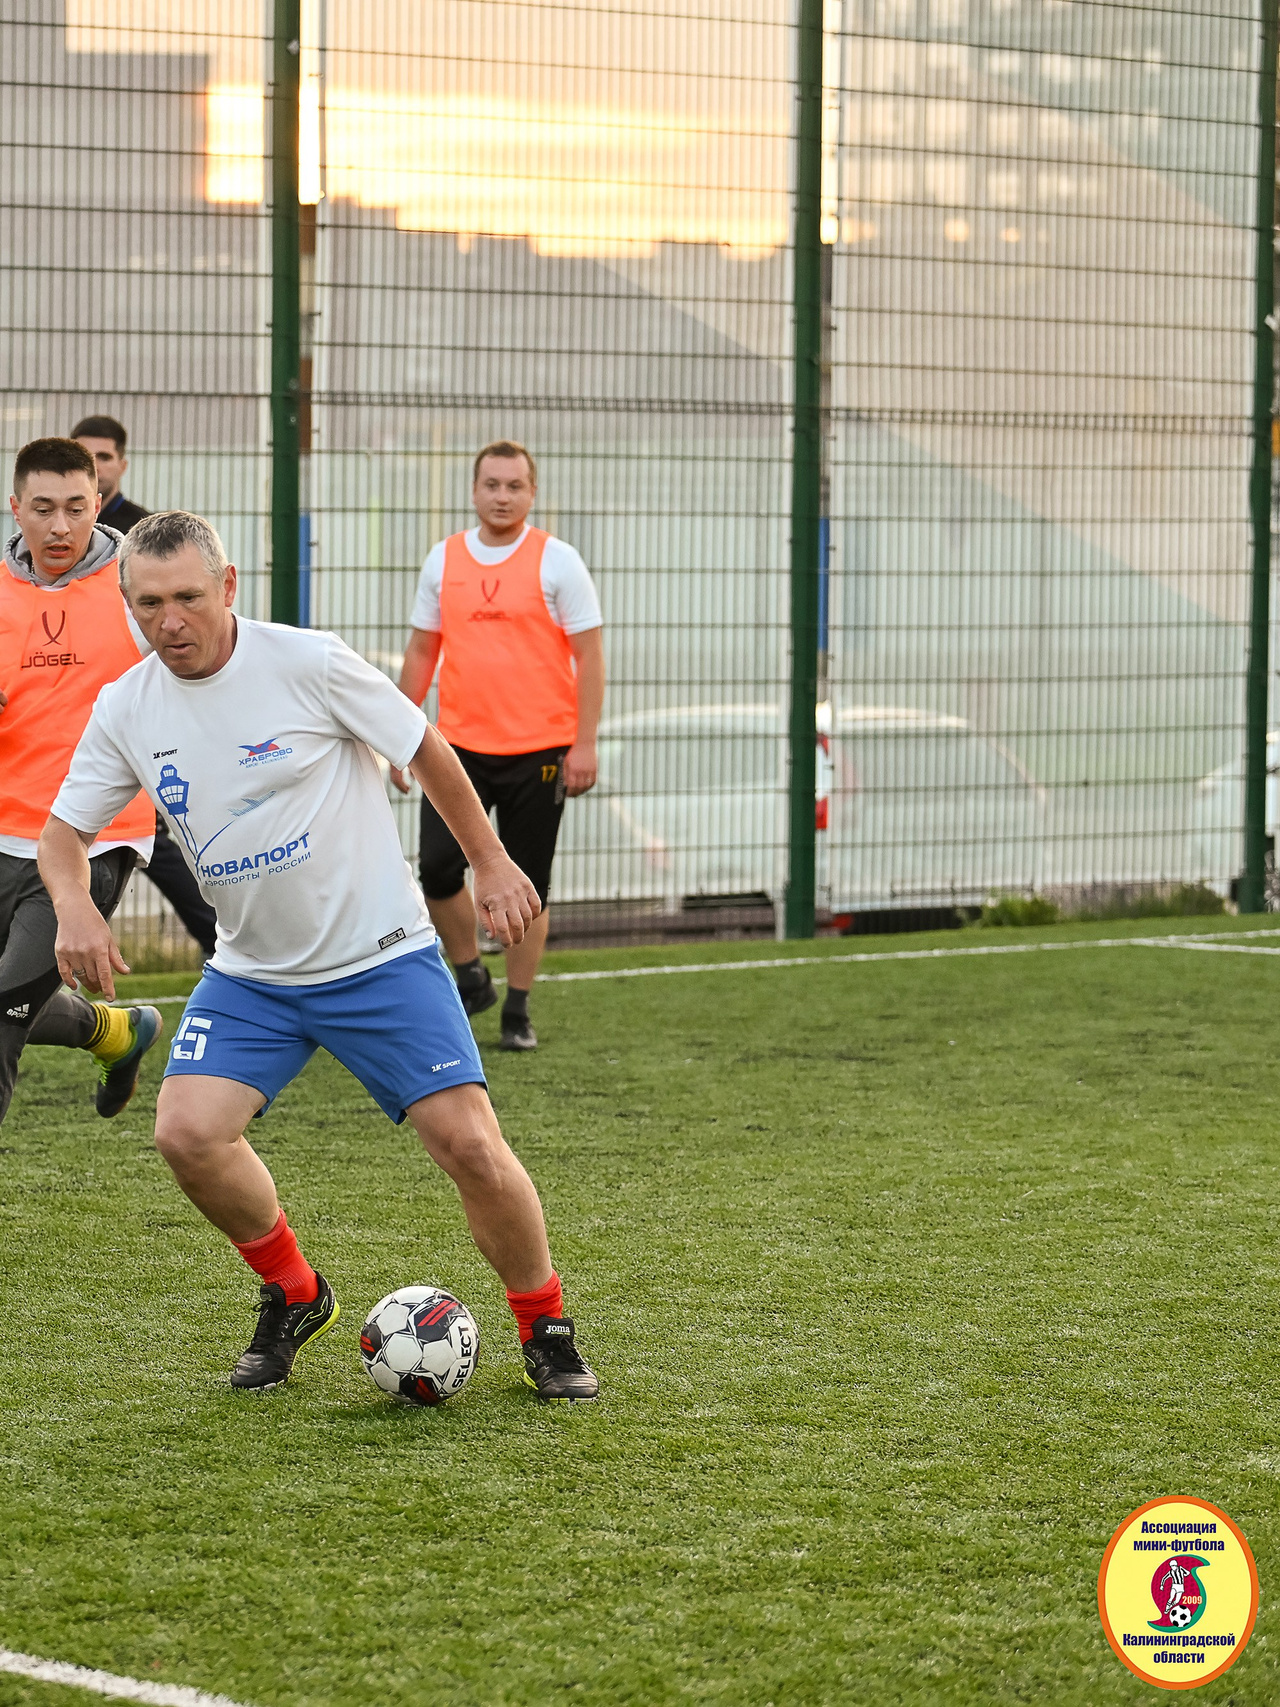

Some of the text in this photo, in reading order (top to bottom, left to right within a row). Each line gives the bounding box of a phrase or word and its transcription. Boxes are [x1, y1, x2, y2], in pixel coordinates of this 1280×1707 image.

[21, 651, 85, 669] JÖGEL
[160, 748, 178, 758] SPORT
[238, 747, 293, 766] ХРАБРОВО
[542, 765, 558, 783] 17
[200, 832, 310, 878] НОВАПОРТ
[268, 851, 312, 876] РОССИИ
[442, 1059, 461, 1069] SPORT
[452, 1326, 472, 1389] SELECT
